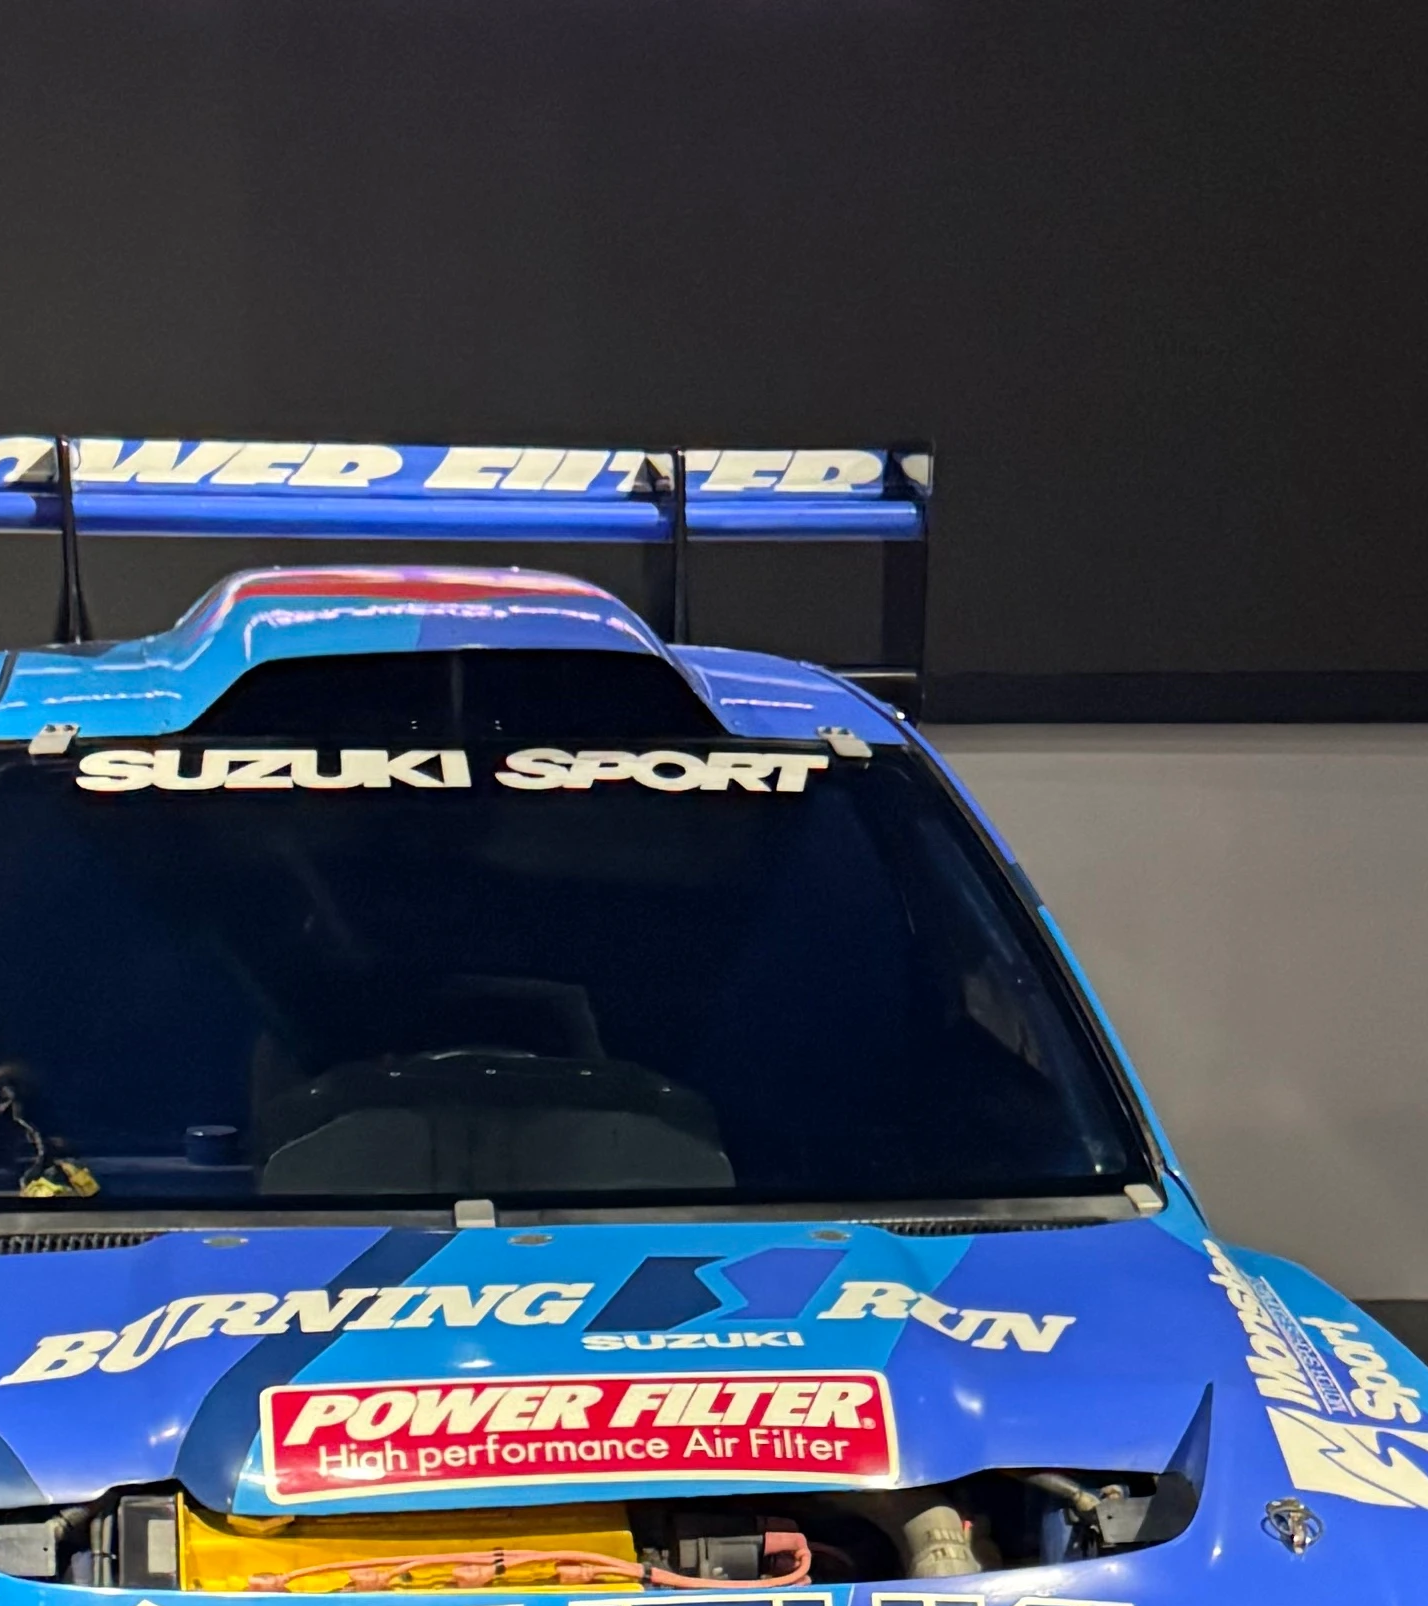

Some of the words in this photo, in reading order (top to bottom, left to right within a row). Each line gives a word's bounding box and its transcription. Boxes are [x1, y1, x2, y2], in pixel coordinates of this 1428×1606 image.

[75, 749, 472, 791] SUZUKI
[495, 747, 830, 793] SPORT
[583, 1332, 803, 1350] SUZUKI
[818, 1282, 1076, 1352] RUN
[1299, 1316, 1422, 1425] Sport
[285, 1383, 604, 1446] POWER
[613, 1380, 874, 1430] FILTER
[318, 1441, 408, 1477] High
[417, 1430, 669, 1473] performance
[682, 1428, 738, 1460] Air
[750, 1427, 851, 1461] Filter
